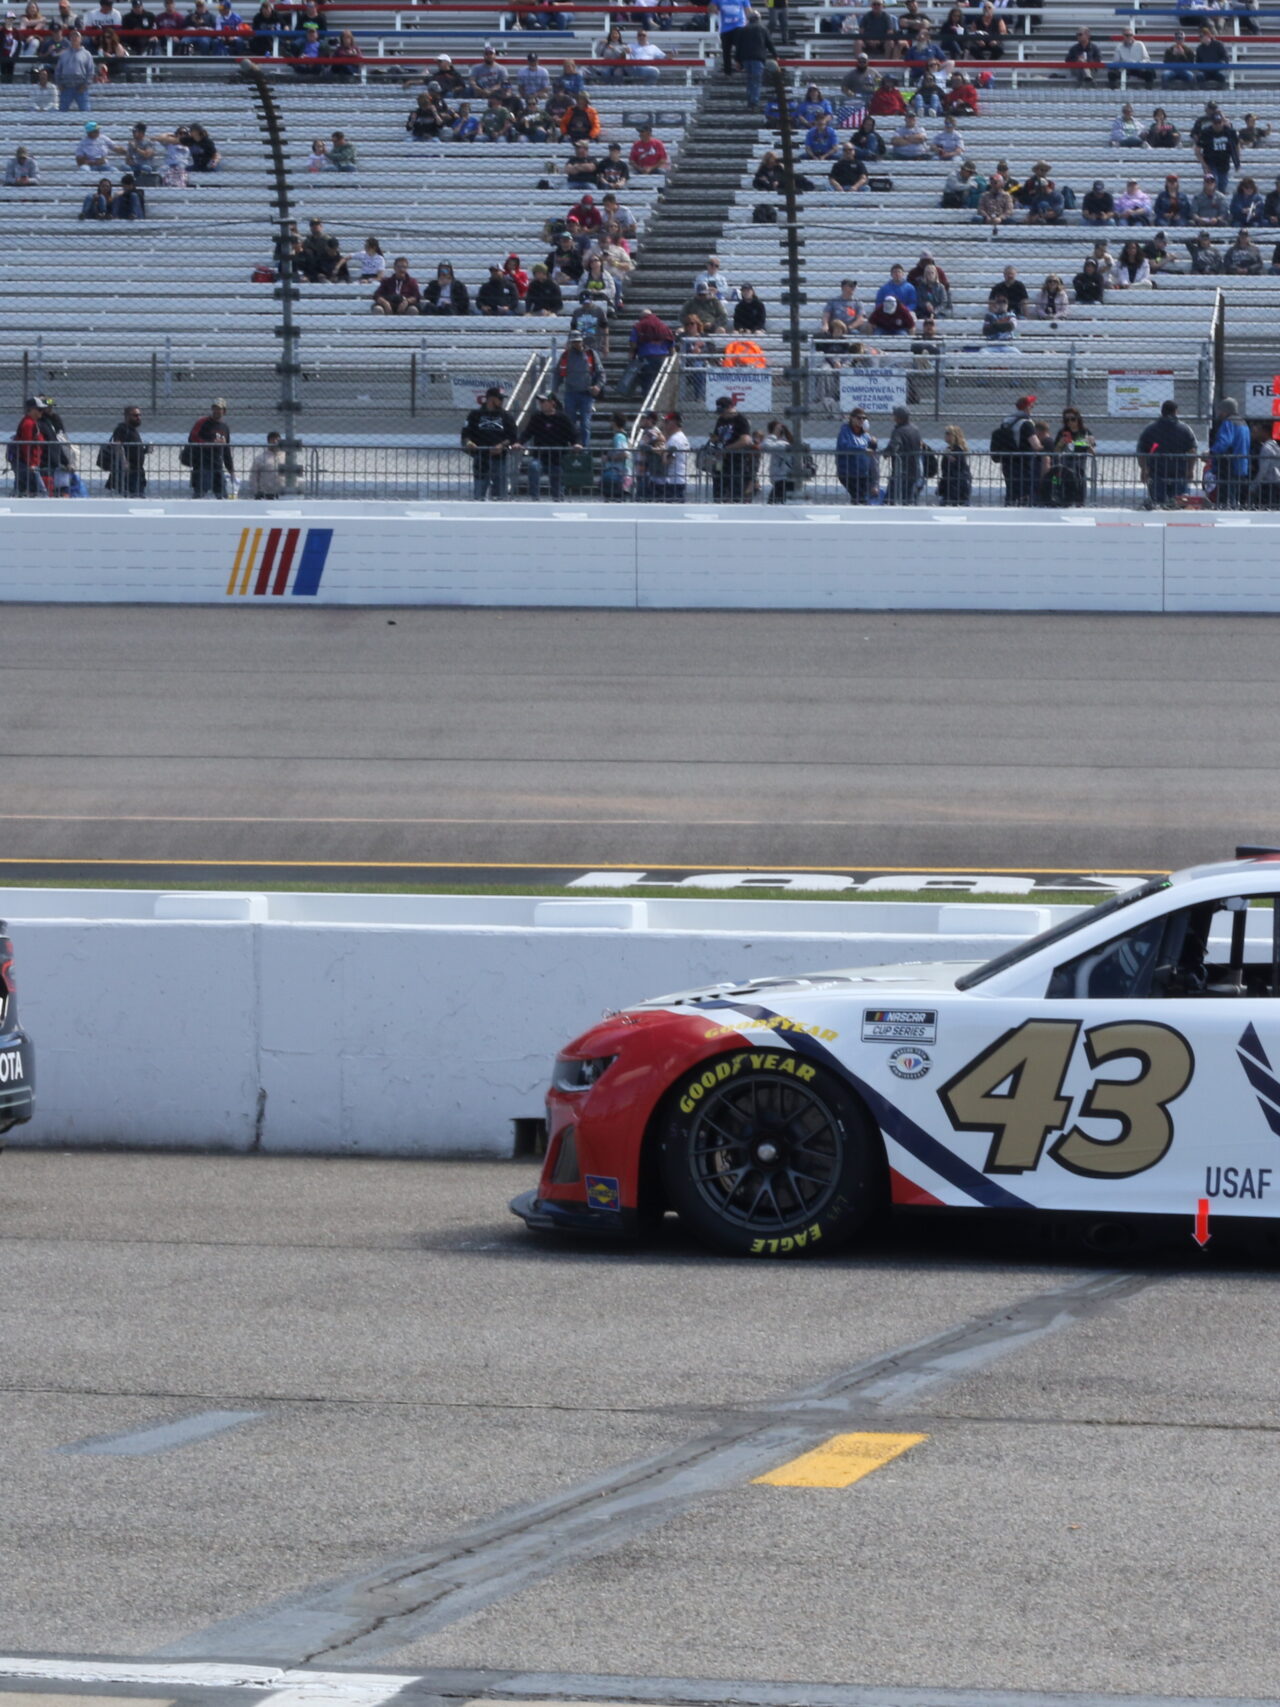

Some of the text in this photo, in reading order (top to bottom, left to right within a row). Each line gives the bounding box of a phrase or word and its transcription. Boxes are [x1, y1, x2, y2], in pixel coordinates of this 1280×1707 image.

[868, 377, 878, 385] TO
[841, 386, 905, 394] COMMONWEALTH
[731, 392, 746, 408] F
[858, 402, 889, 410] SECTION
[887, 1011, 927, 1023] NASCAR
[704, 1016, 839, 1042] GOODYEAR
[872, 1025, 927, 1037] CUP SERIES
[679, 1053, 817, 1114] GOODYEAR
[936, 1017, 1196, 1180] 43
[1205, 1166, 1273, 1200] USAF
[750, 1222, 823, 1255] EAGLE
